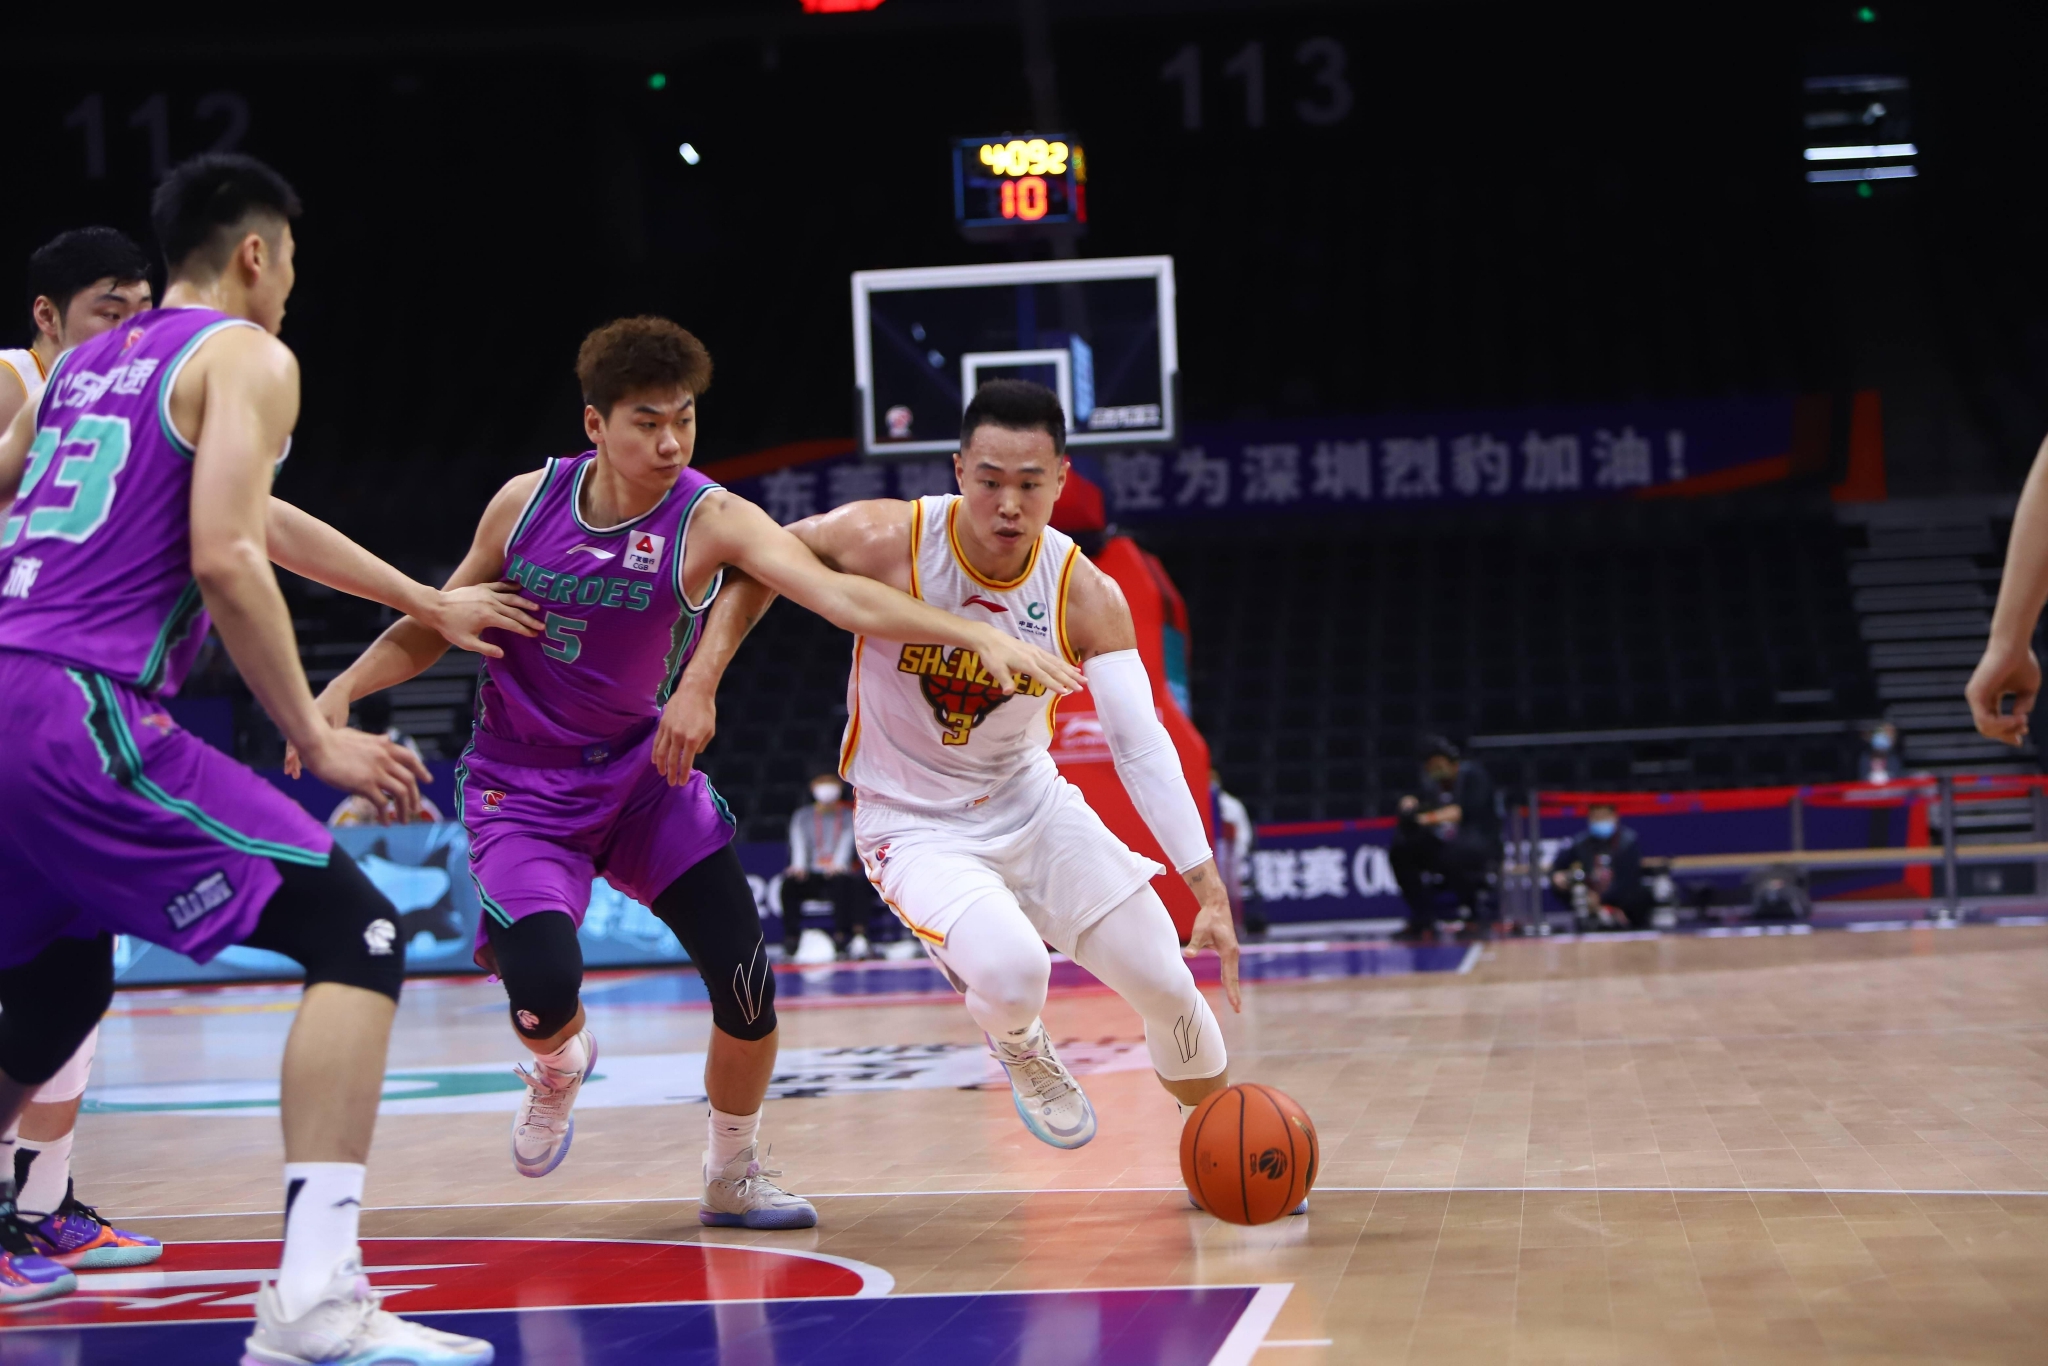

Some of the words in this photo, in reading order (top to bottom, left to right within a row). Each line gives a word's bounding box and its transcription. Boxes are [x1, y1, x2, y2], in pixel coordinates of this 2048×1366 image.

[1160, 35, 1354, 130] 113
[61, 90, 251, 180] 112
[1001, 176, 1048, 221] 10
[0, 414, 132, 549] 23
[506, 554, 654, 613] HEROES
[633, 562, 648, 570] CGB
[541, 611, 588, 664] 5
[897, 643, 1048, 697] SHENZEN
[942, 711, 976, 746] 3
